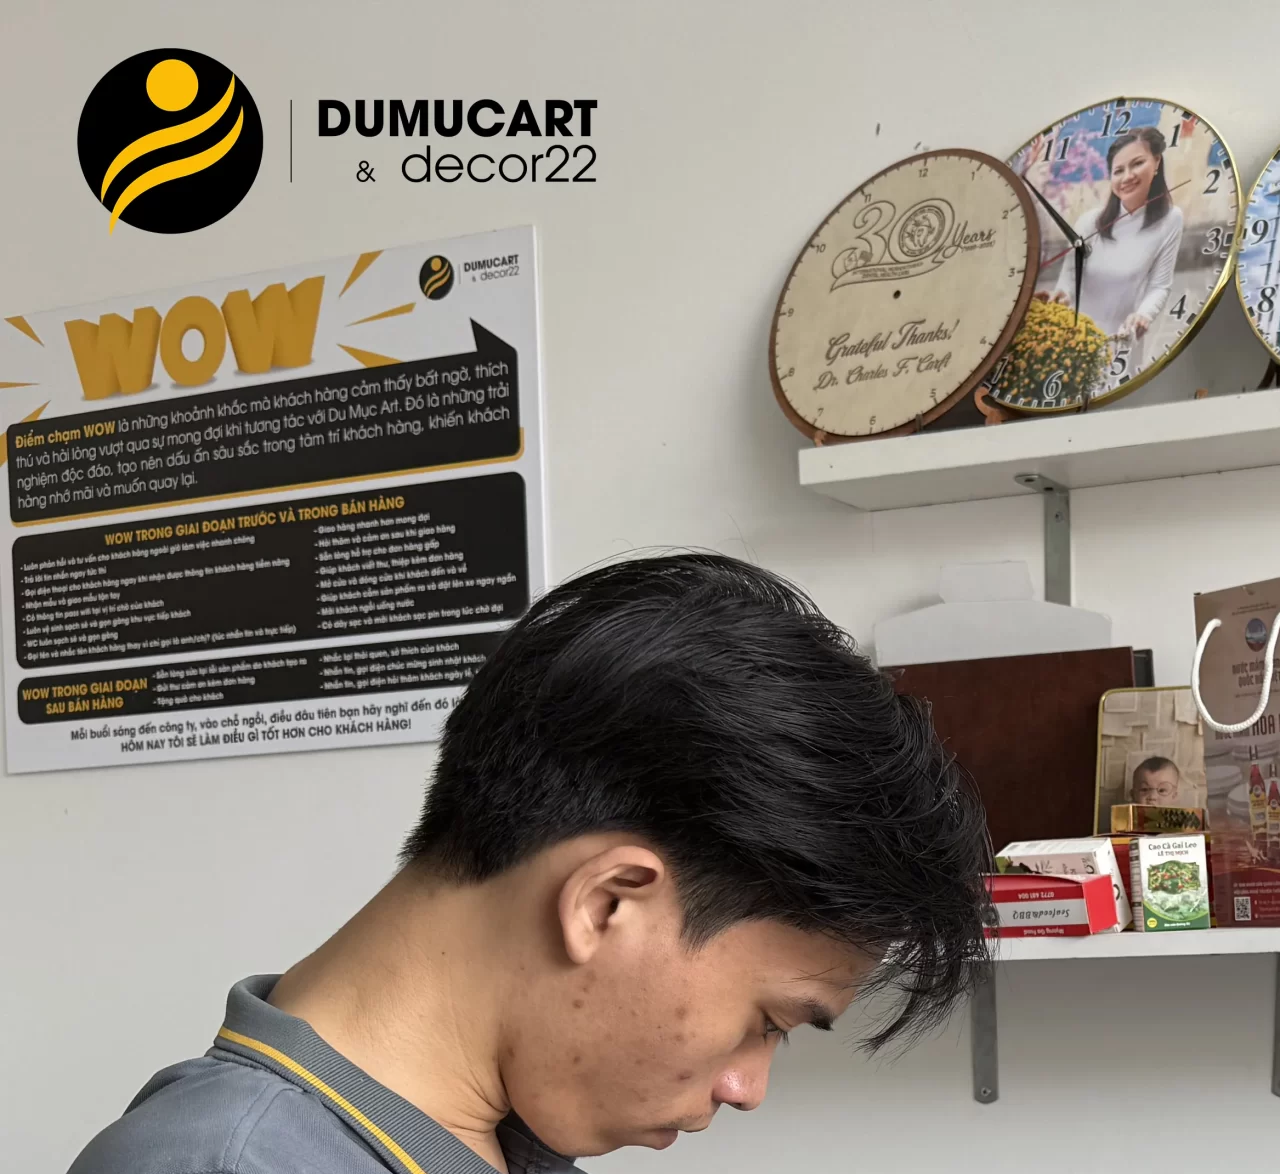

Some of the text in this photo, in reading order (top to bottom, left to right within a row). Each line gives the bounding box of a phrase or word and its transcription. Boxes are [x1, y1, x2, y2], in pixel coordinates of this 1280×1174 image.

[1100, 111, 1132, 138] 12
[1168, 123, 1181, 148] 1
[1203, 169, 1221, 195] 2
[942, 219, 997, 259] Years
[1203, 227, 1224, 255] 3
[464, 254, 519, 272] DUMUCART
[480, 265, 520, 281] decor22
[1169, 295, 1187, 320] 4
[64, 275, 325, 400] WOW
[825, 318, 960, 366] Grateful Thanks!
[812, 370, 838, 391] Dr.
[846, 364, 888, 385] Charles
[47, 427, 81, 445] chạm
[84, 421, 116, 438] WOW
[118, 418, 129, 433] là
[132, 413, 168, 430] những
[171, 404, 215, 425] khoảnh
[217, 398, 248, 417] khắc
[251, 396, 271, 413] mà
[273, 389, 313, 409] khách
[315, 385, 348, 404] hàng
[351, 380, 381, 398] cảm
[384, 374, 413, 393] thấy
[475, 361, 509, 379] thích
[18, 491, 47, 510] hàng
[50, 486, 71, 505] nhớ
[96, 481, 112, 497] và
[113, 474, 147, 496] muốn
[149, 474, 179, 493] quay
[105, 496, 405, 546] WOW TRONG GIAI ĐOẠN TRƯỚC VÀ TRONG BÁN HÀNG
[22, 678, 148, 701] WOW TRONG GIAI ĐOẠN
[46, 695, 124, 715] SAU BÁN HÀNG
[121, 740, 144, 752] HÔM
[146, 738, 166, 751] NAY
[168, 736, 184, 748] TÔI
[200, 732, 220, 746] LÀM
[247, 727, 259, 743] GÌ
[283, 722, 305, 739] HƠN
[308, 721, 332, 737] CHO
[335, 717, 373, 735] KHÁCH
[376, 718, 412, 734] HÀNG!
[1148, 843, 1161, 851] Cao
[1184, 841, 1197, 849] Leo
